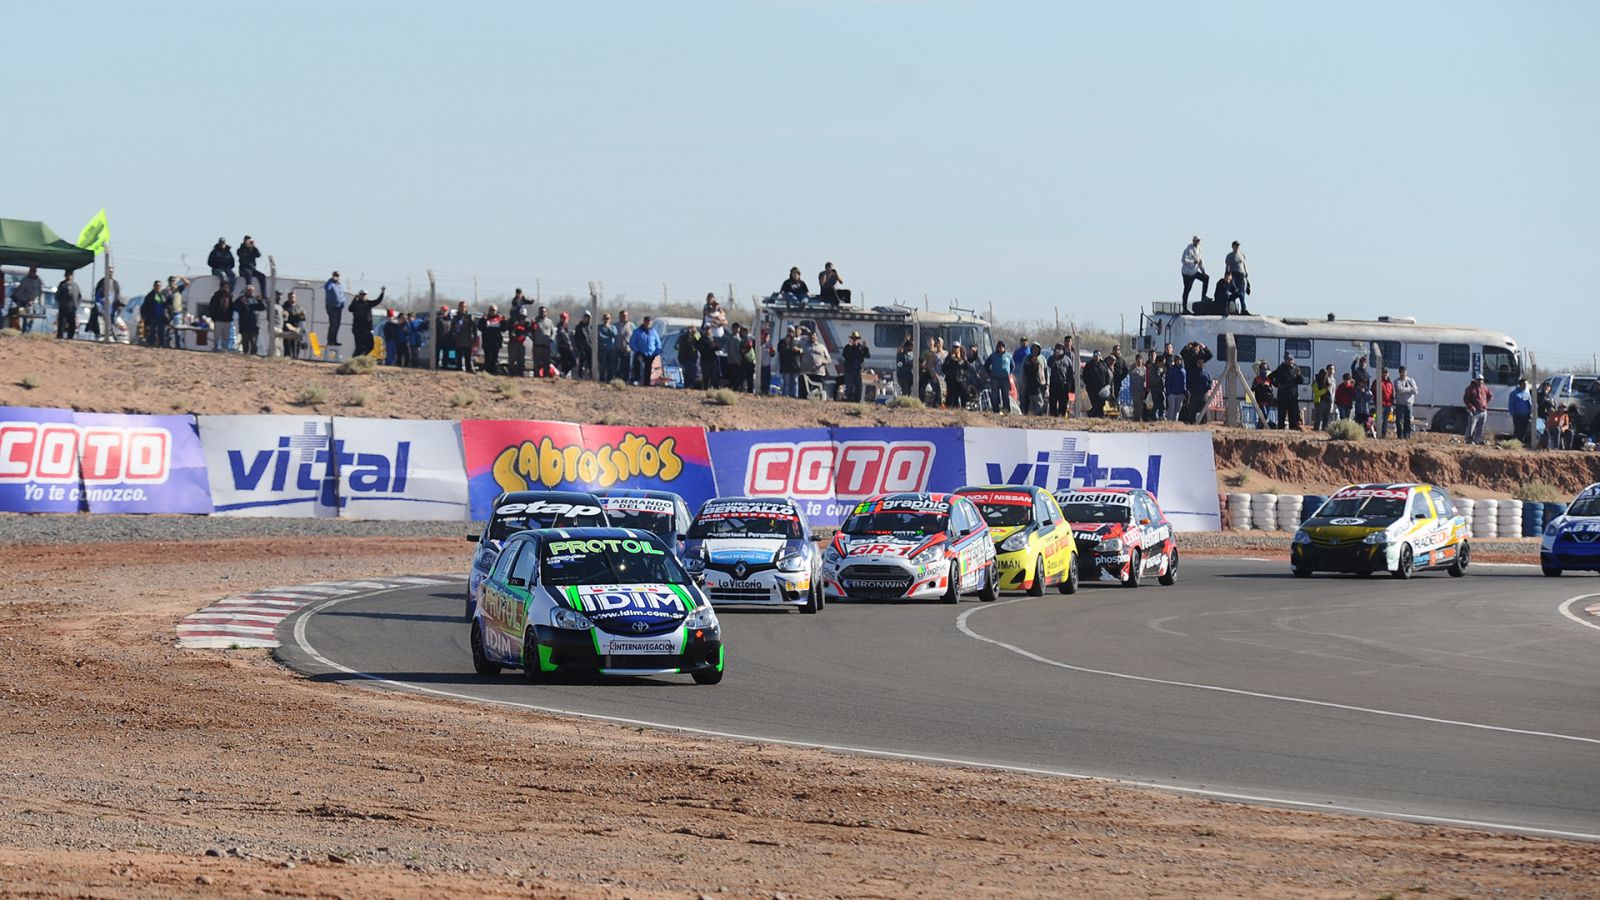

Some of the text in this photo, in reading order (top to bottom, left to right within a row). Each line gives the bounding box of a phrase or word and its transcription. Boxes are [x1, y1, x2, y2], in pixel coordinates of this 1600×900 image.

[0, 427, 166, 479] COTO
[228, 422, 411, 507] vittal
[751, 446, 931, 494] COTO
[24, 484, 44, 500] Yo
[49, 485, 65, 500] te
[1338, 489, 1407, 499] WEGA
[496, 501, 602, 517] etap
[613, 499, 671, 508] ARMANDO
[703, 506, 794, 515] BERGALLO
[806, 501, 820, 516] te
[882, 500, 949, 511] graphic
[549, 539, 664, 555] PROTOIL
[849, 544, 912, 556] GR-1
[719, 578, 762, 588] La Victoria
[852, 580, 910, 588] BRONWAY
[580, 592, 684, 611] IDIM
